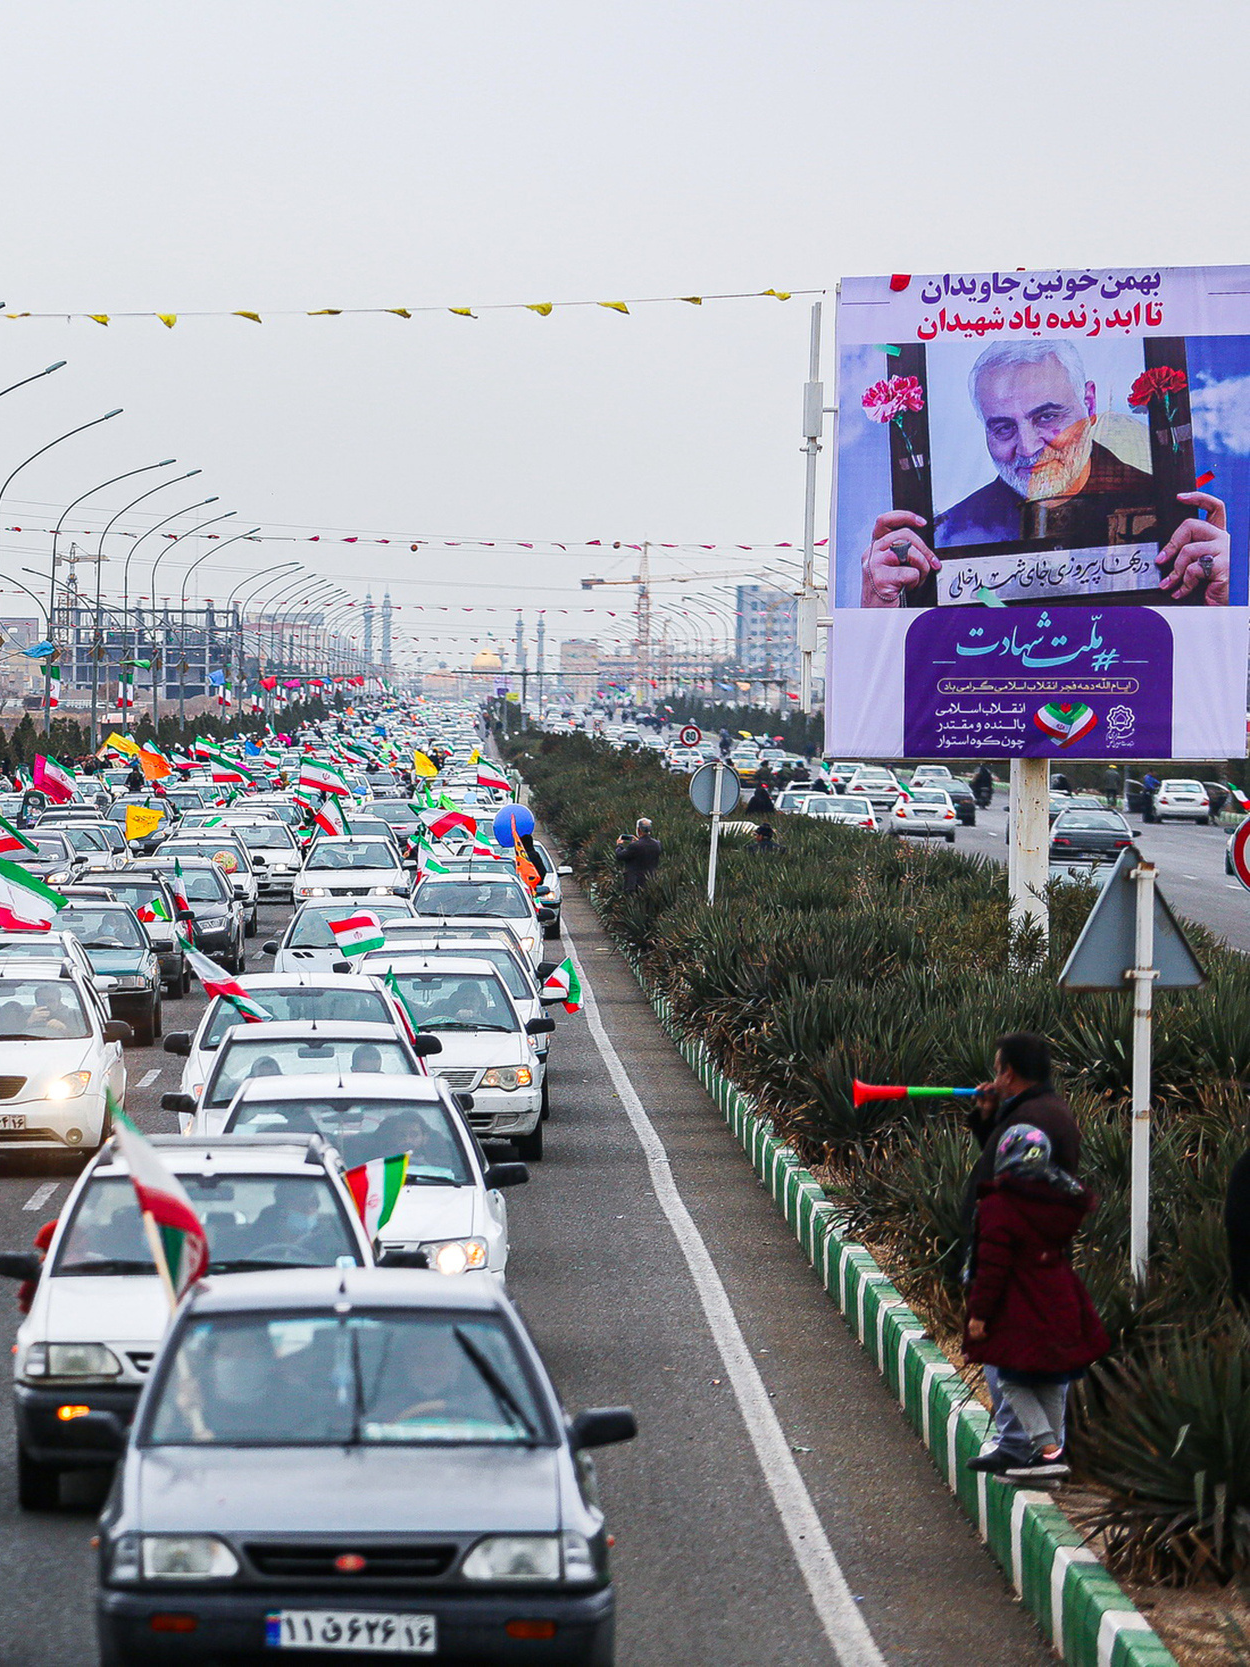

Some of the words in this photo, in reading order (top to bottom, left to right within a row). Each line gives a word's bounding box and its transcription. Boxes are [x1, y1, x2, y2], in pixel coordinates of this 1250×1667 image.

[921, 271, 1021, 304] جاویدان
[1022, 269, 1099, 301] خونین
[1100, 271, 1161, 299] بهمن
[1008, 304, 1041, 336] یاد
[1046, 303, 1101, 337] زنده
[1105, 301, 1140, 334] ابد
[1145, 301, 1164, 328] تا
[917, 306, 1005, 341] شهیدان
[956, 611, 1052, 657] شهادت
[1027, 681, 1058, 692] انقلاب
[1059, 681, 1077, 693] فجر
[935, 702, 982, 717] اسلامی
[983, 702, 1026, 716] انقلاب
[936, 720, 975, 733] مقتدر
[976, 722, 983, 732] و
[984, 719, 1026, 731] بالنده
[685, 731, 696, 742] 80
[936, 735, 969, 749] استوار
[970, 735, 1001, 747] کوه
[1000, 737, 1025, 749] چون
